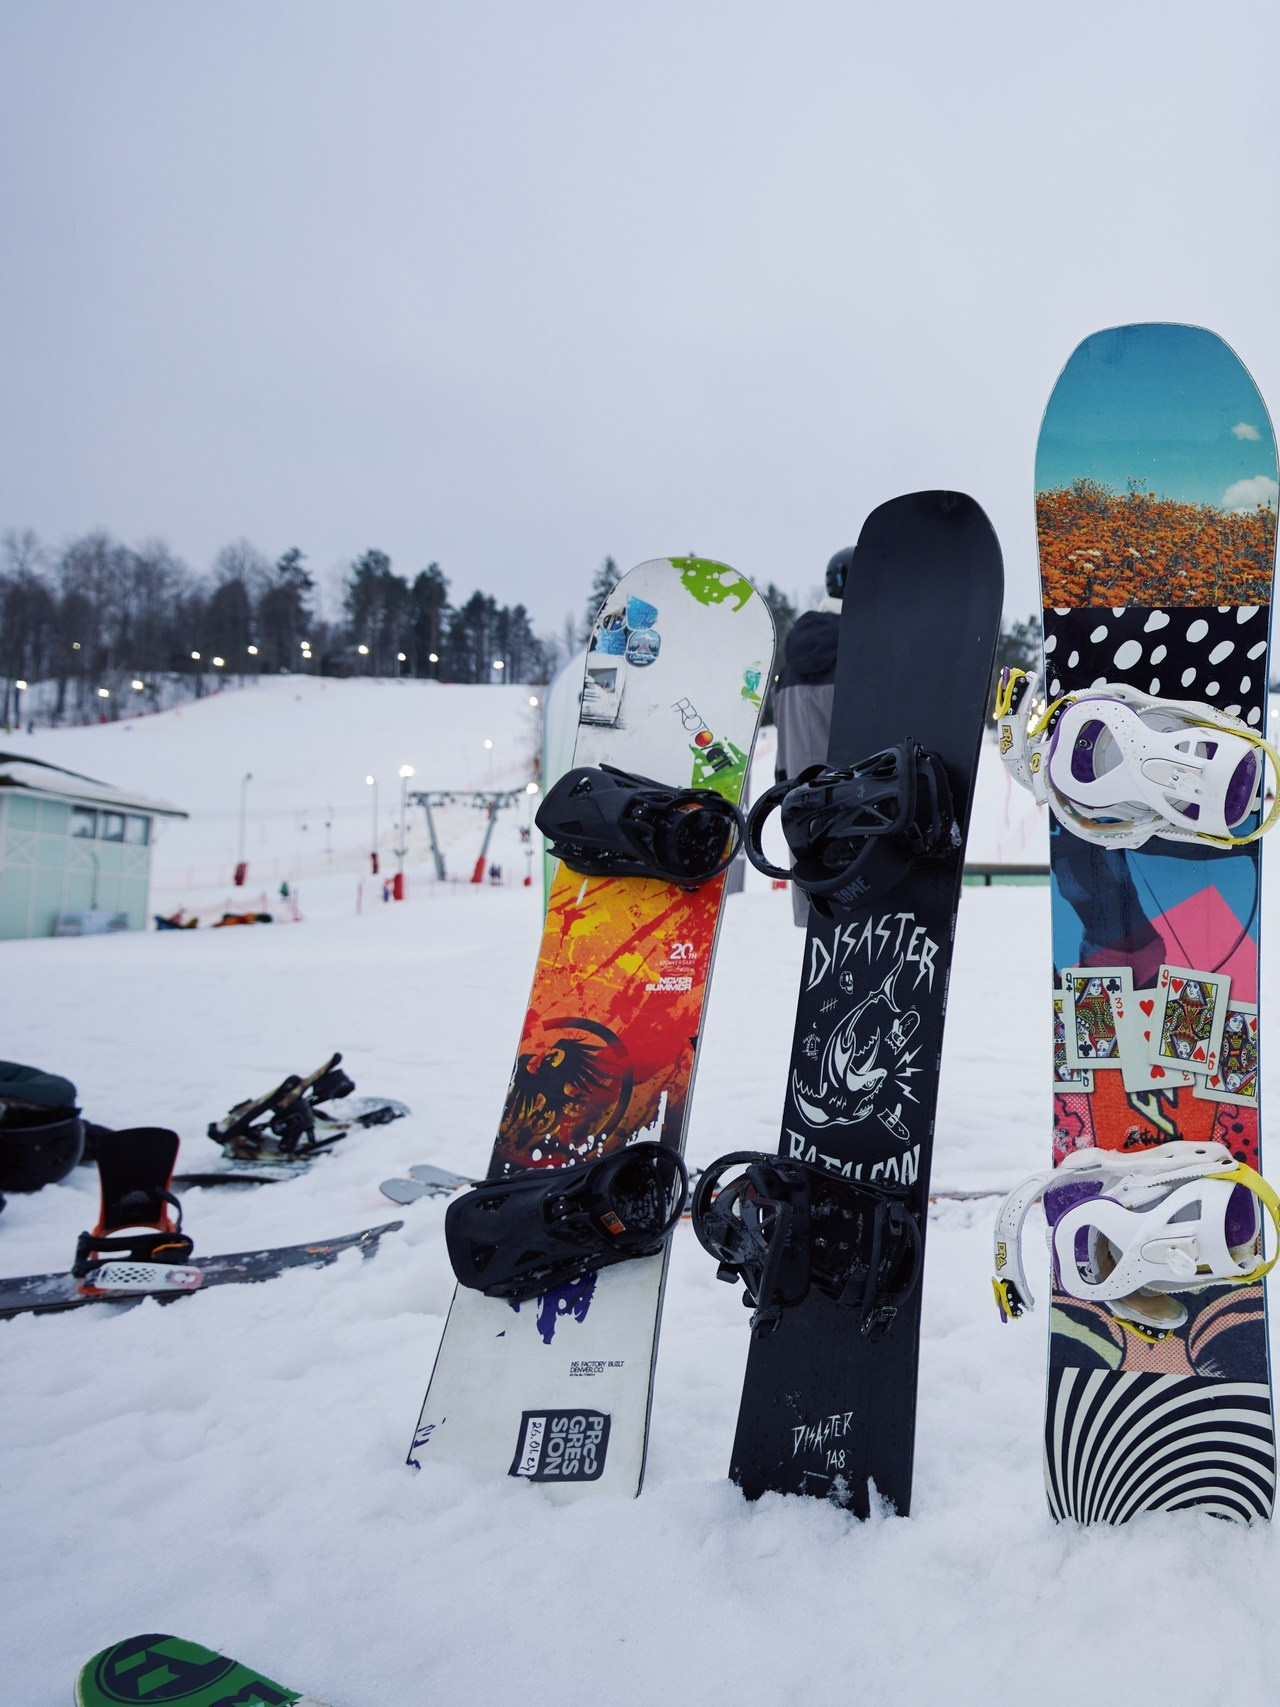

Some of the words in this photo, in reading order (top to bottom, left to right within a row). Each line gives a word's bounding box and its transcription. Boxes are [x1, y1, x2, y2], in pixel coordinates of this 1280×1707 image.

[806, 912, 940, 994] DISASTER
[1065, 973, 1073, 984] Q
[1162, 970, 1170, 981] Q
[1115, 998, 1123, 1008] 3
[543, 1417, 568, 1475] SION
[562, 1416, 586, 1475] GRES
[791, 1411, 854, 1459] DISASTER
[826, 1449, 846, 1471] 148
